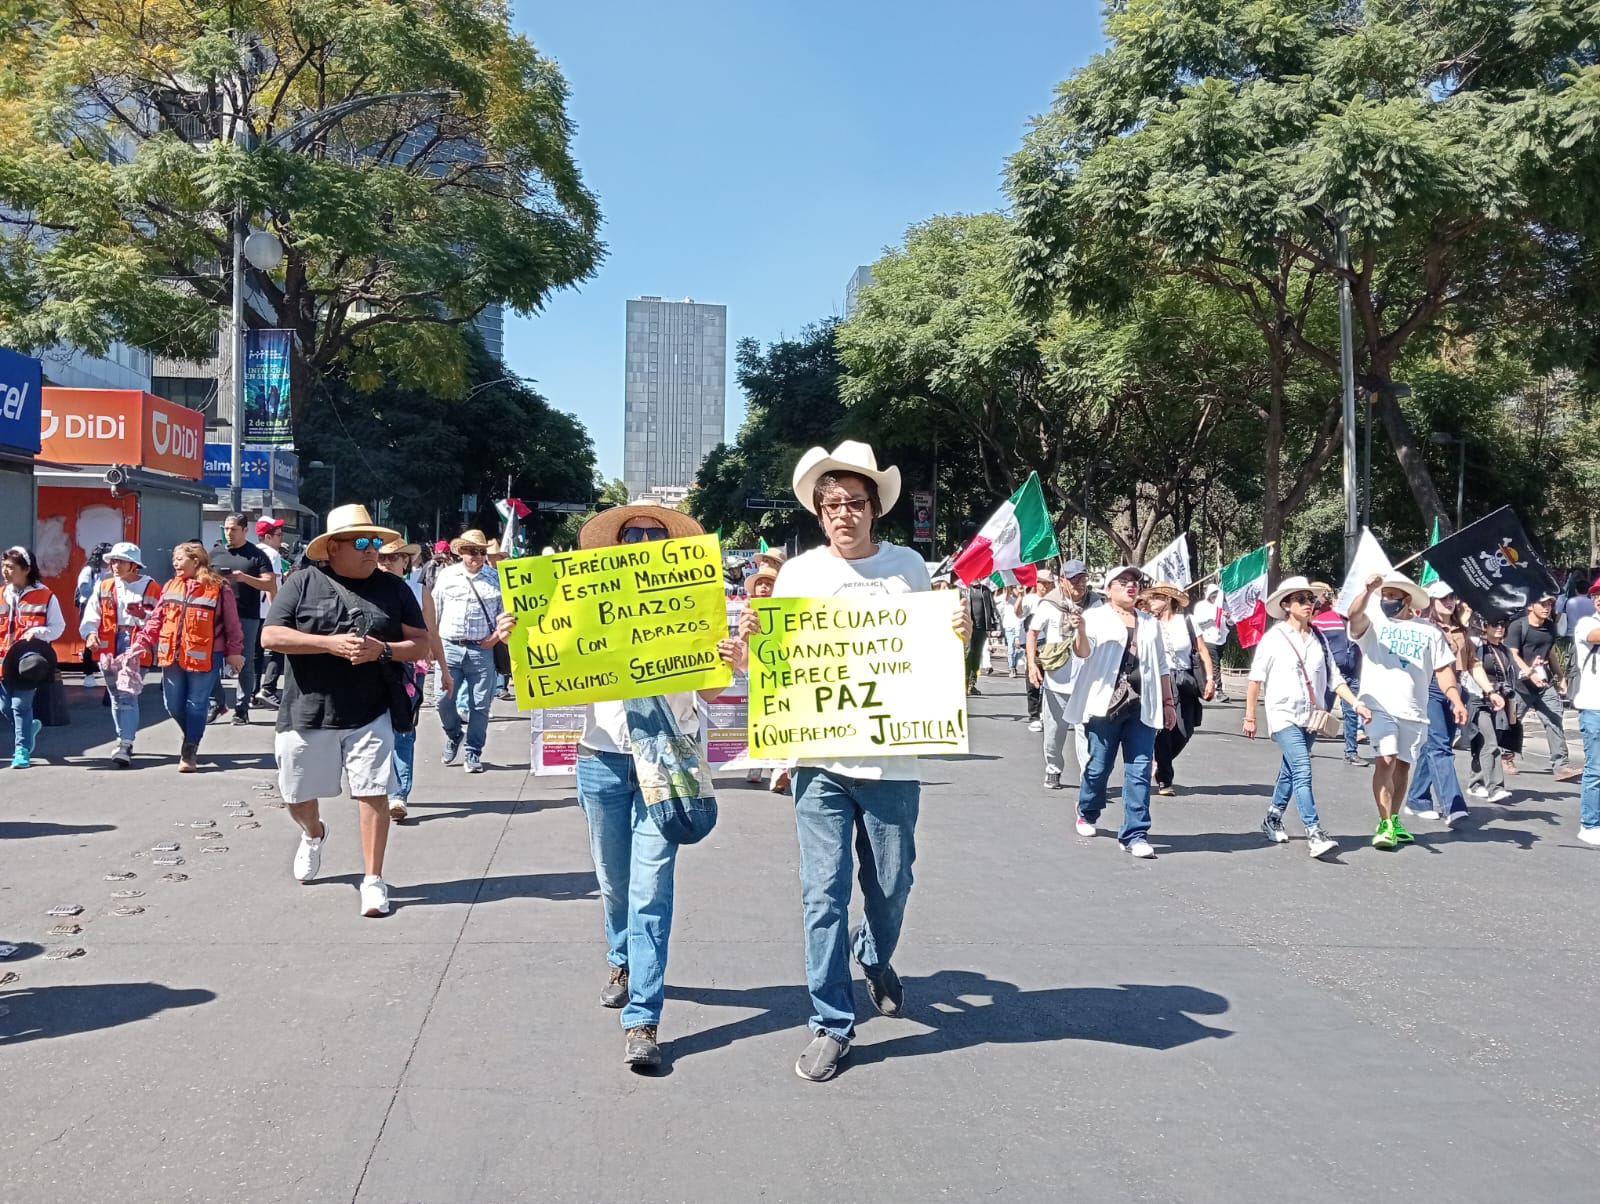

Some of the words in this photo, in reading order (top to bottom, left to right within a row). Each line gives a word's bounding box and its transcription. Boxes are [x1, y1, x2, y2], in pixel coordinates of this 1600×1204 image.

[65, 414, 125, 440] DiDi
[172, 423, 198, 460] DiDi
[505, 566, 532, 590] EN
[552, 551, 650, 580] JERÉCUARO
[513, 594, 549, 613] NOS
[562, 578, 622, 602] ESTAN
[538, 614, 573, 635] CON
[598, 595, 696, 625] BALAZOS
[758, 604, 907, 636] JERÉCUARO
[526, 643, 559, 666] NO
[577, 637, 608, 656] CON
[631, 619, 710, 646] ABRAZOS
[757, 637, 904, 666] GUANAJUATO
[1388, 640, 1423, 660] ROCK
[761, 664, 850, 689] MERECE
[868, 661, 913, 675] VIVIR
[763, 695, 791, 716] EN
[815, 681, 883, 713] PAZ
[868, 708, 965, 745] JUSTICIA!
